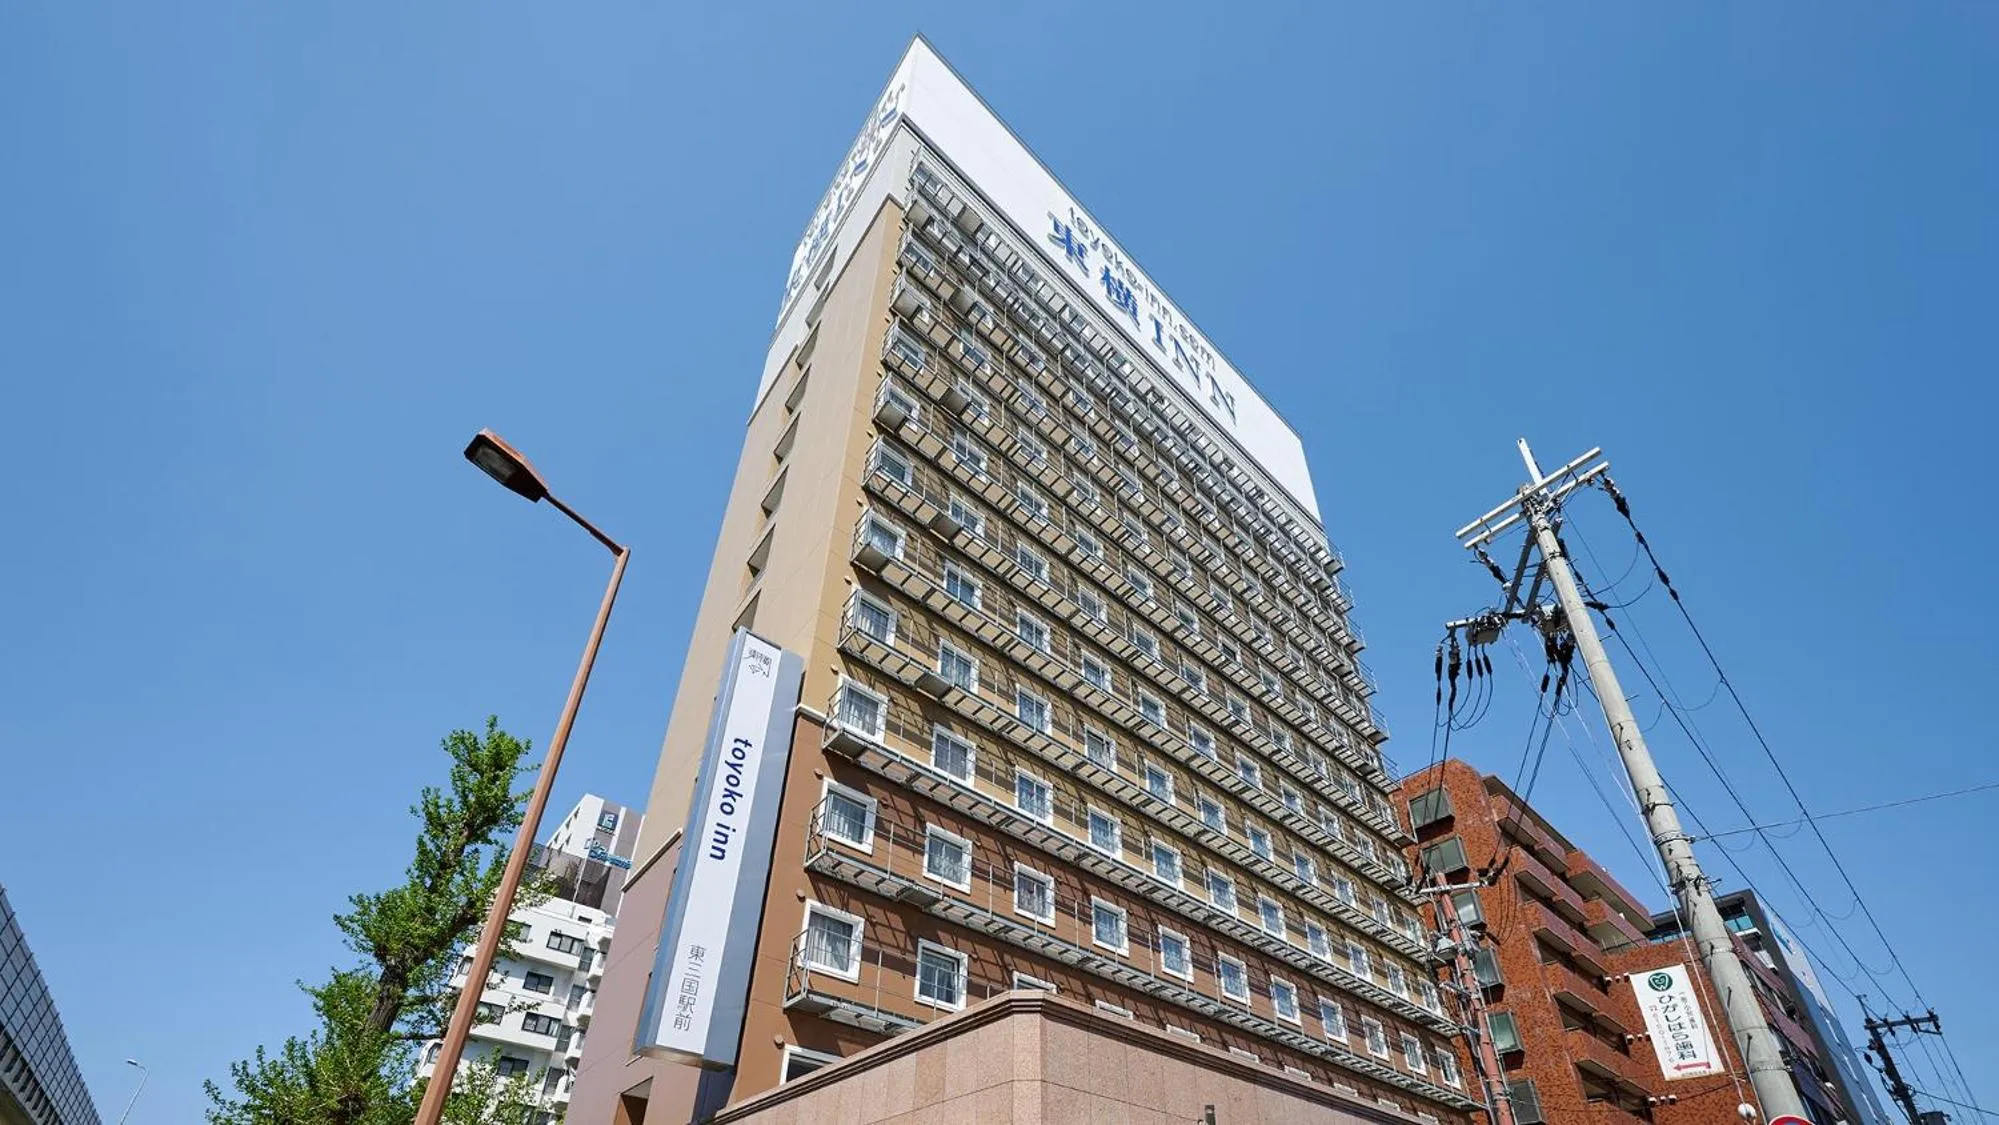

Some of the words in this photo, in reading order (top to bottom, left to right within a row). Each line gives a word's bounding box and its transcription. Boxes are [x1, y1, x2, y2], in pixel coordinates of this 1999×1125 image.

[1069, 207, 1216, 370] toyoko-inn.com
[720, 738, 752, 815] toyoko
[710, 822, 736, 861] inn
[674, 945, 706, 1031] 東三国駅前
